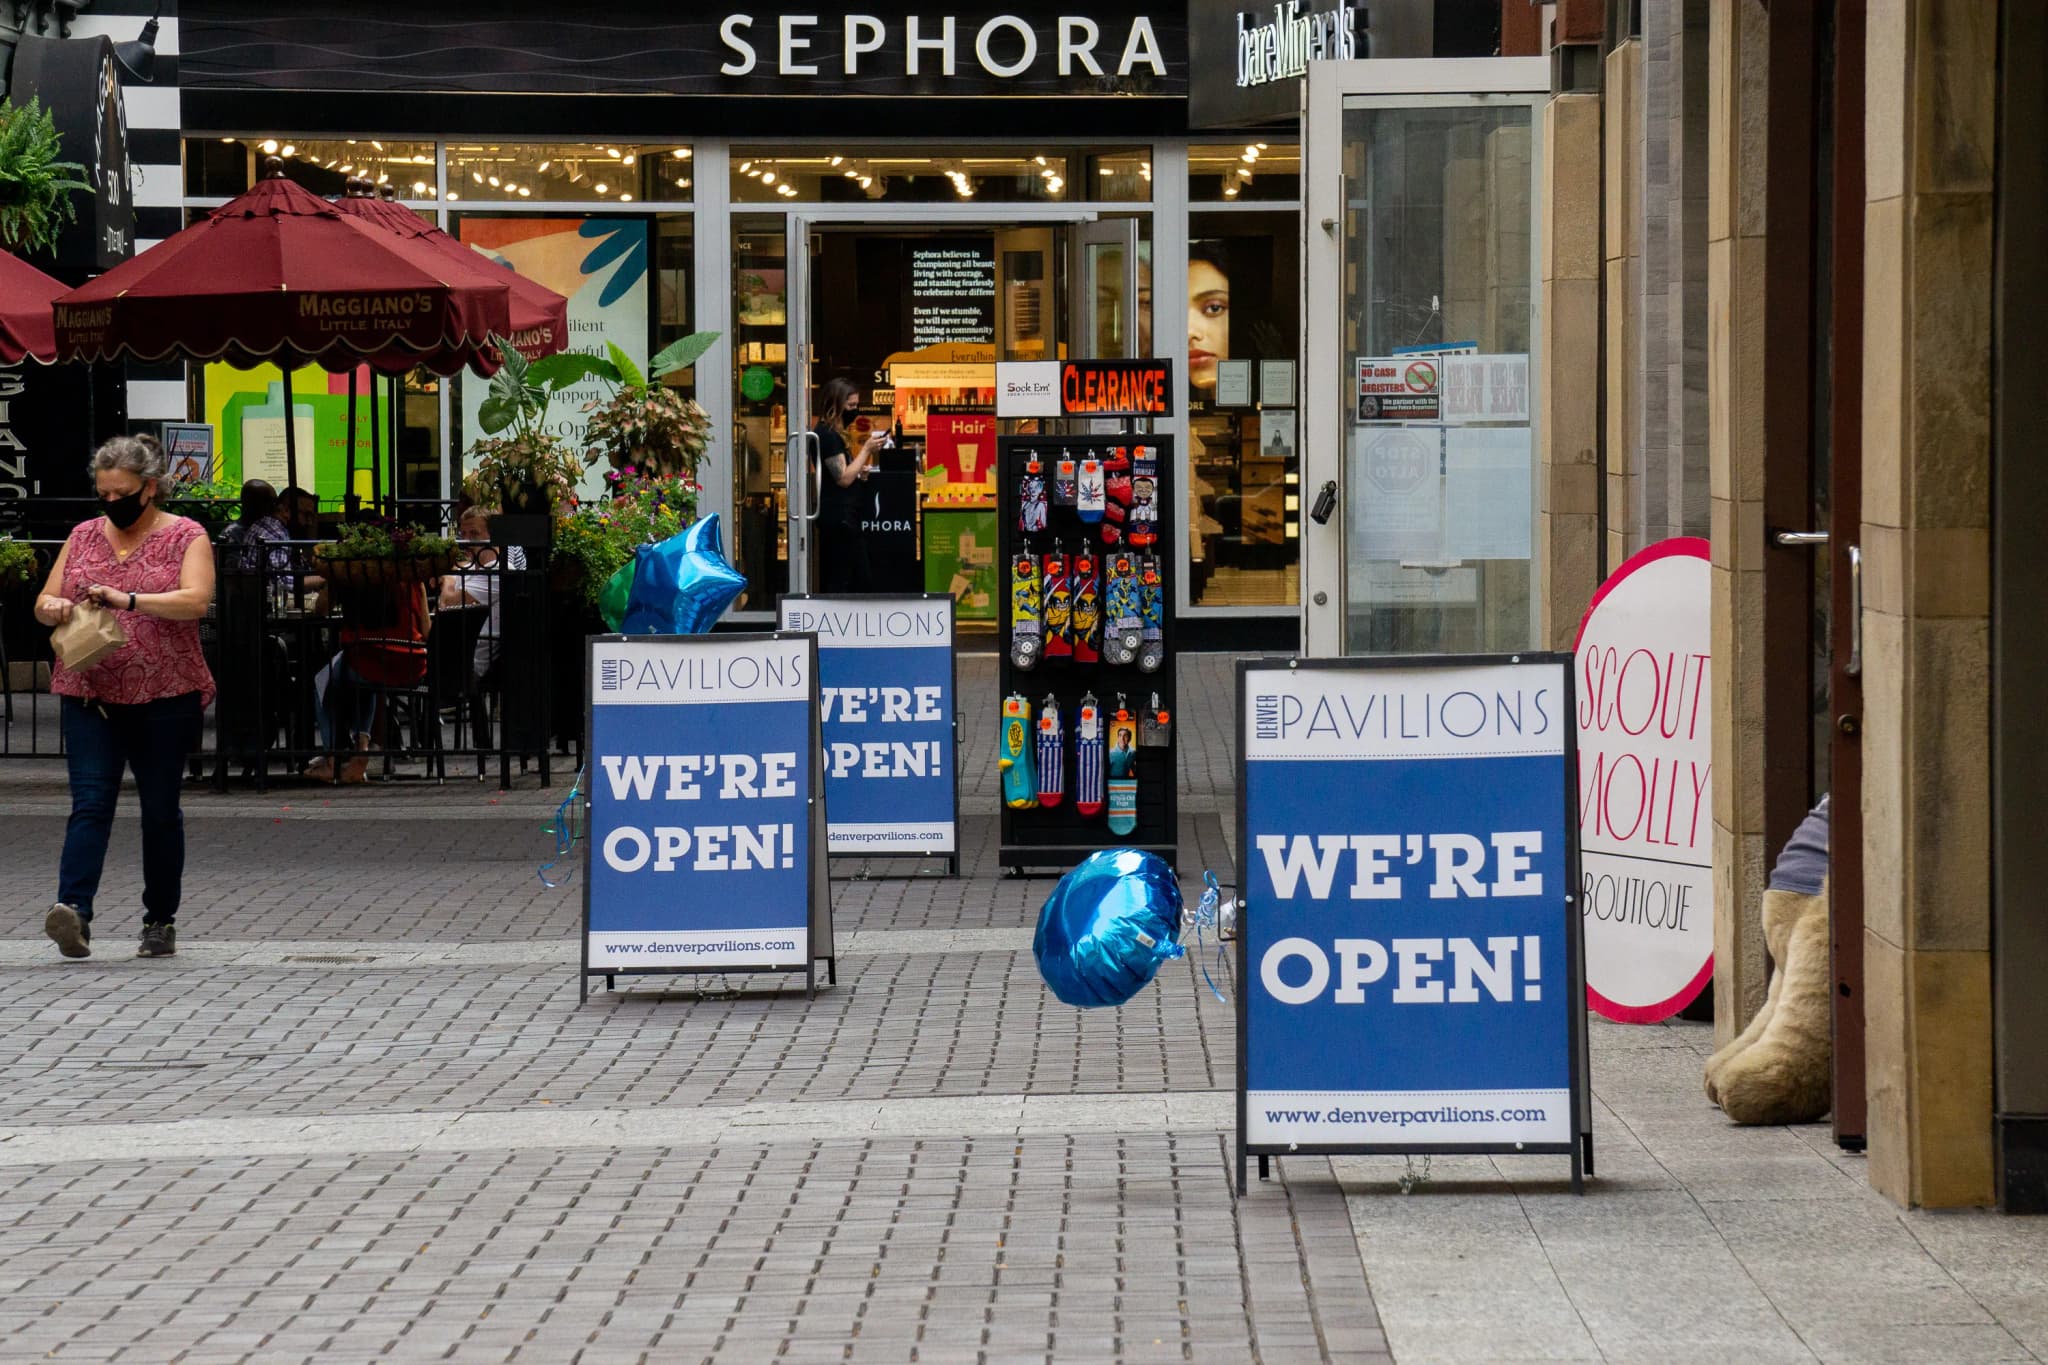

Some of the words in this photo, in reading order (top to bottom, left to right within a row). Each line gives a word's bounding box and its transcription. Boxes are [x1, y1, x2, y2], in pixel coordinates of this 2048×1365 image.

[720, 14, 1168, 76] SEPHORA
[1236, 0, 1355, 87] bareMinerals
[913, 251, 941, 260] Sephora
[913, 270, 935, 279] living
[936, 270, 953, 278] with
[928, 280, 961, 288] standing
[300, 292, 433, 317] MAGGIANO'S
[913, 307, 931, 315] Even
[569, 319, 605, 332] ilient
[925, 317, 940, 325] will
[961, 318, 977, 327] stop
[510, 327, 553, 347] IANO'S
[913, 327, 945, 335] building
[951, 350, 996, 362] Everythin
[1361, 368, 1373, 377] NO
[1374, 368, 1397, 377] CASH
[1007, 382, 1032, 392] Sock
[1063, 364, 1165, 413] CLEARANCE
[1361, 383, 1406, 393] REGISTERS
[551, 390, 600, 404] upport
[339, 414, 368, 423] OLY
[951, 421, 986, 434] Hair
[328, 439, 371, 448] SEPOR
[861, 521, 912, 532] PHORA
[802, 611, 944, 637] PAVILIONS
[602, 659, 617, 690] DENVER
[619, 655, 801, 691] PAVILIONS
[1579, 644, 1711, 740] SCOUT
[1256, 695, 1278, 739] DENVER
[1281, 688, 1548, 740] PAVILIONS
[823, 741, 941, 778] PEN!
[601, 752, 796, 801] WE'RE
[828, 831, 944, 843] denverpavilions.com
[603, 823, 794, 873] OPEN!
[1256, 830, 1543, 899] WE'RE
[1583, 872, 1693, 931] BOUTIQUE
[605, 939, 796, 955] www.denverpavilions.com
[1260, 935, 1542, 1005] OPEN!
[1265, 1106, 1547, 1127] www.denverpavilions.com
